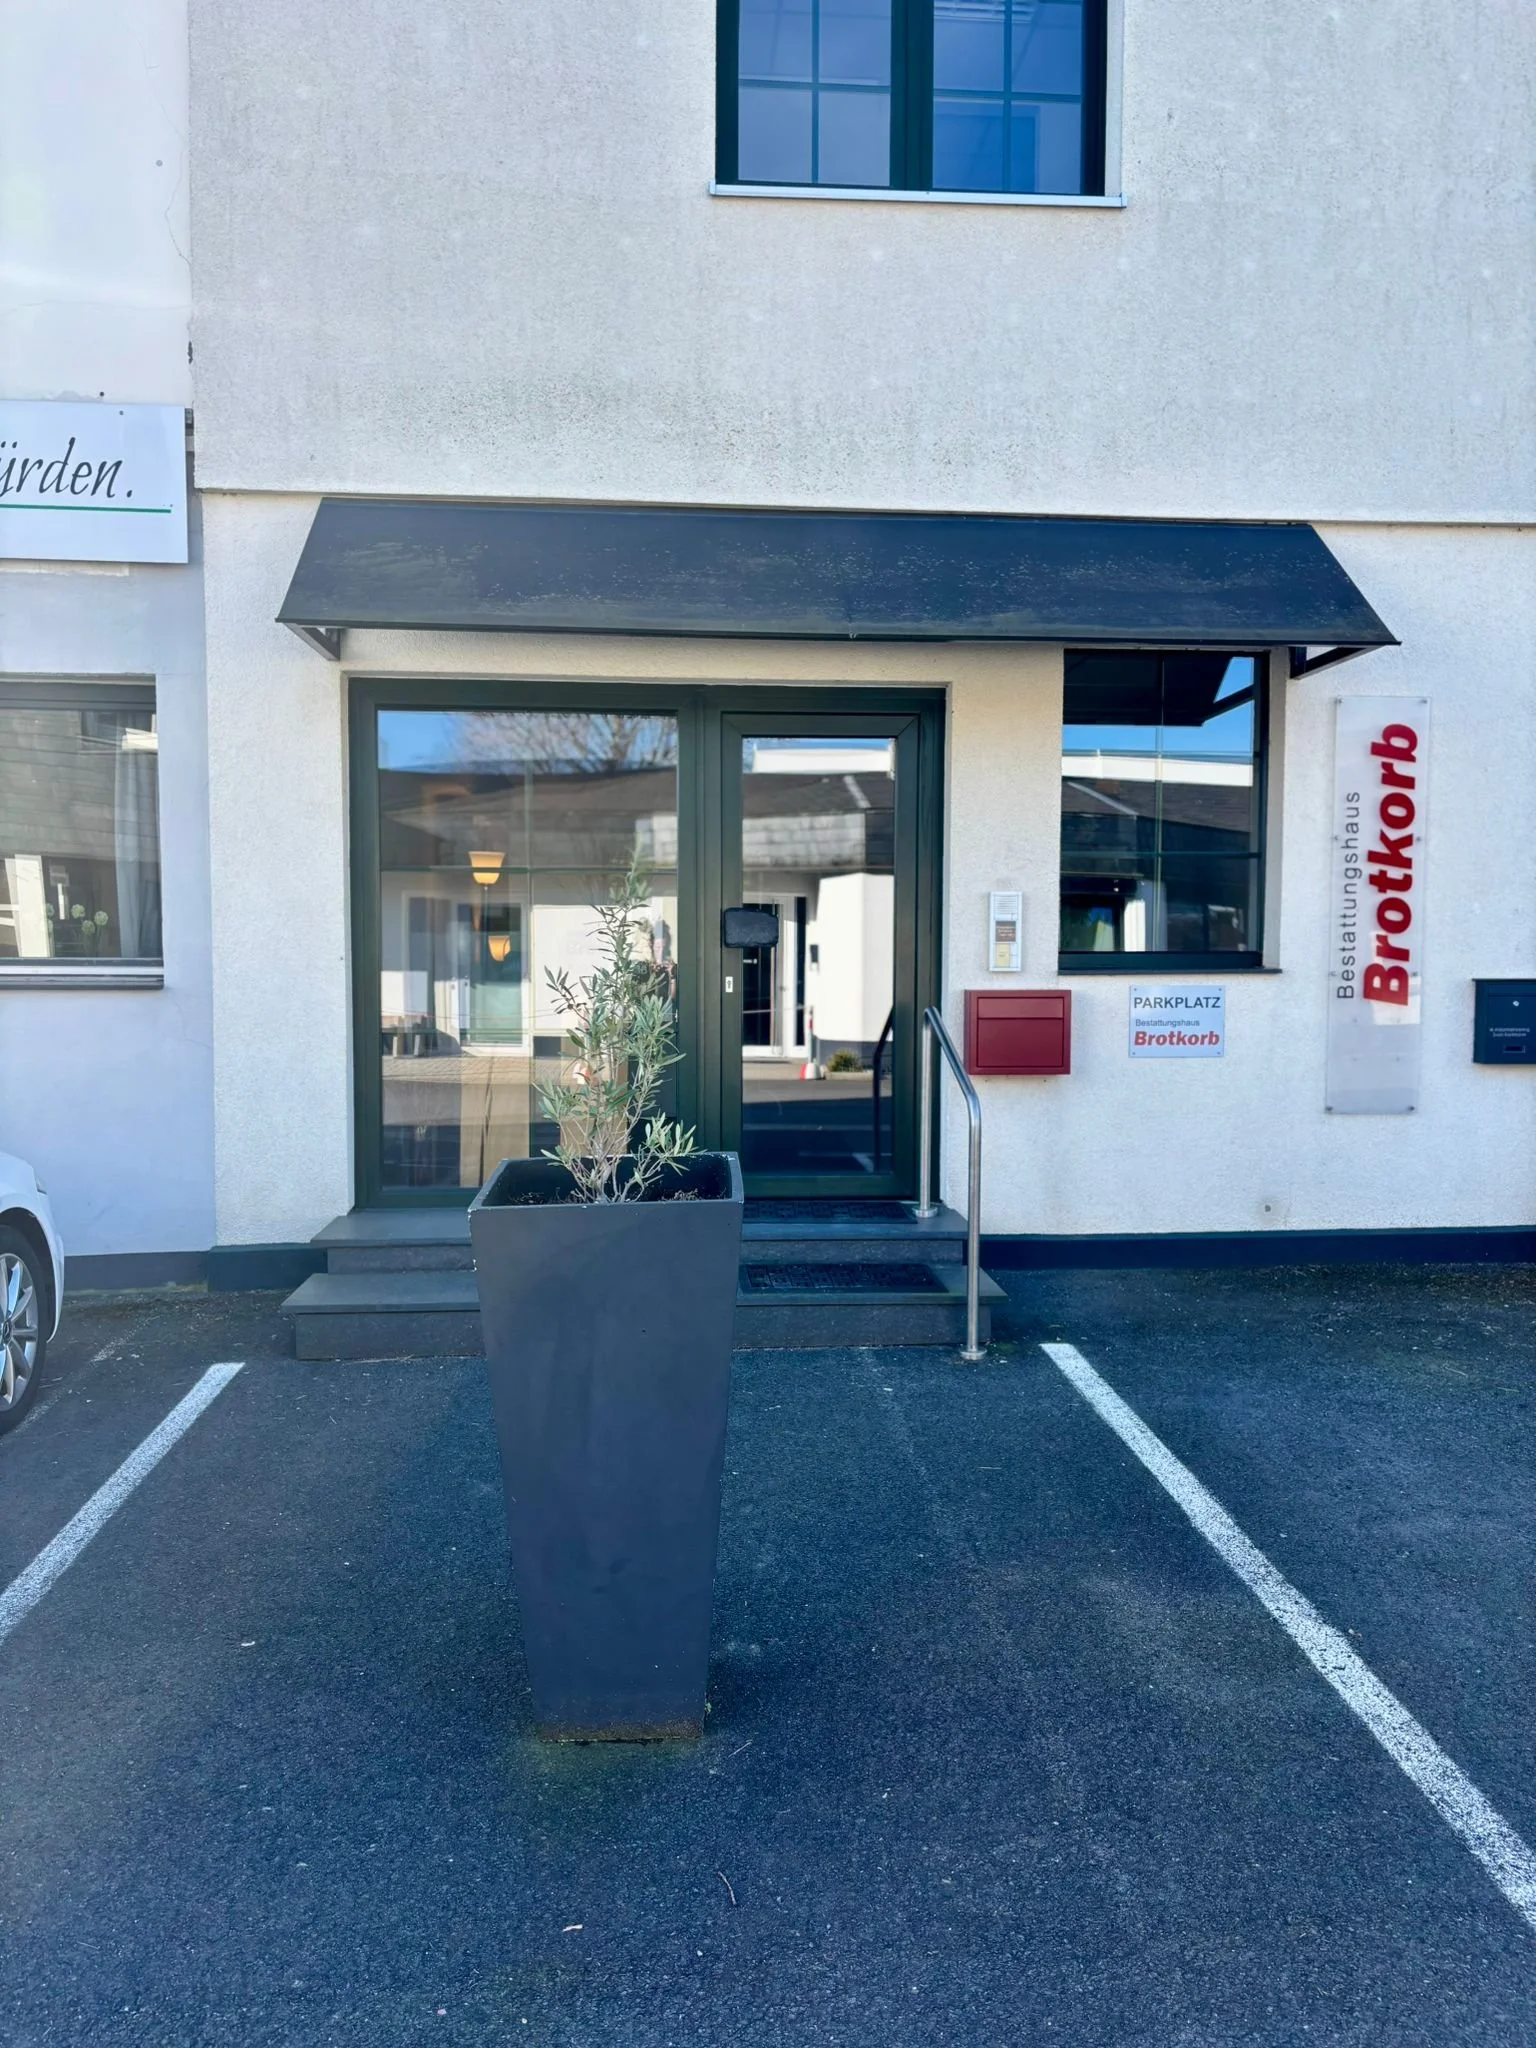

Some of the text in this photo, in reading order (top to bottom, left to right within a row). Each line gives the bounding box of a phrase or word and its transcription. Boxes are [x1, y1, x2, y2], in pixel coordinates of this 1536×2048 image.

[1363, 723, 1418, 1006] Brotkorb
[1337, 792, 1362, 999] Bestattungshaus
[1133, 996, 1221, 1009] PARKPLATZ
[1135, 1019, 1200, 1028] Bestattungshaus
[1134, 1030, 1220, 1046] Brotkorb
